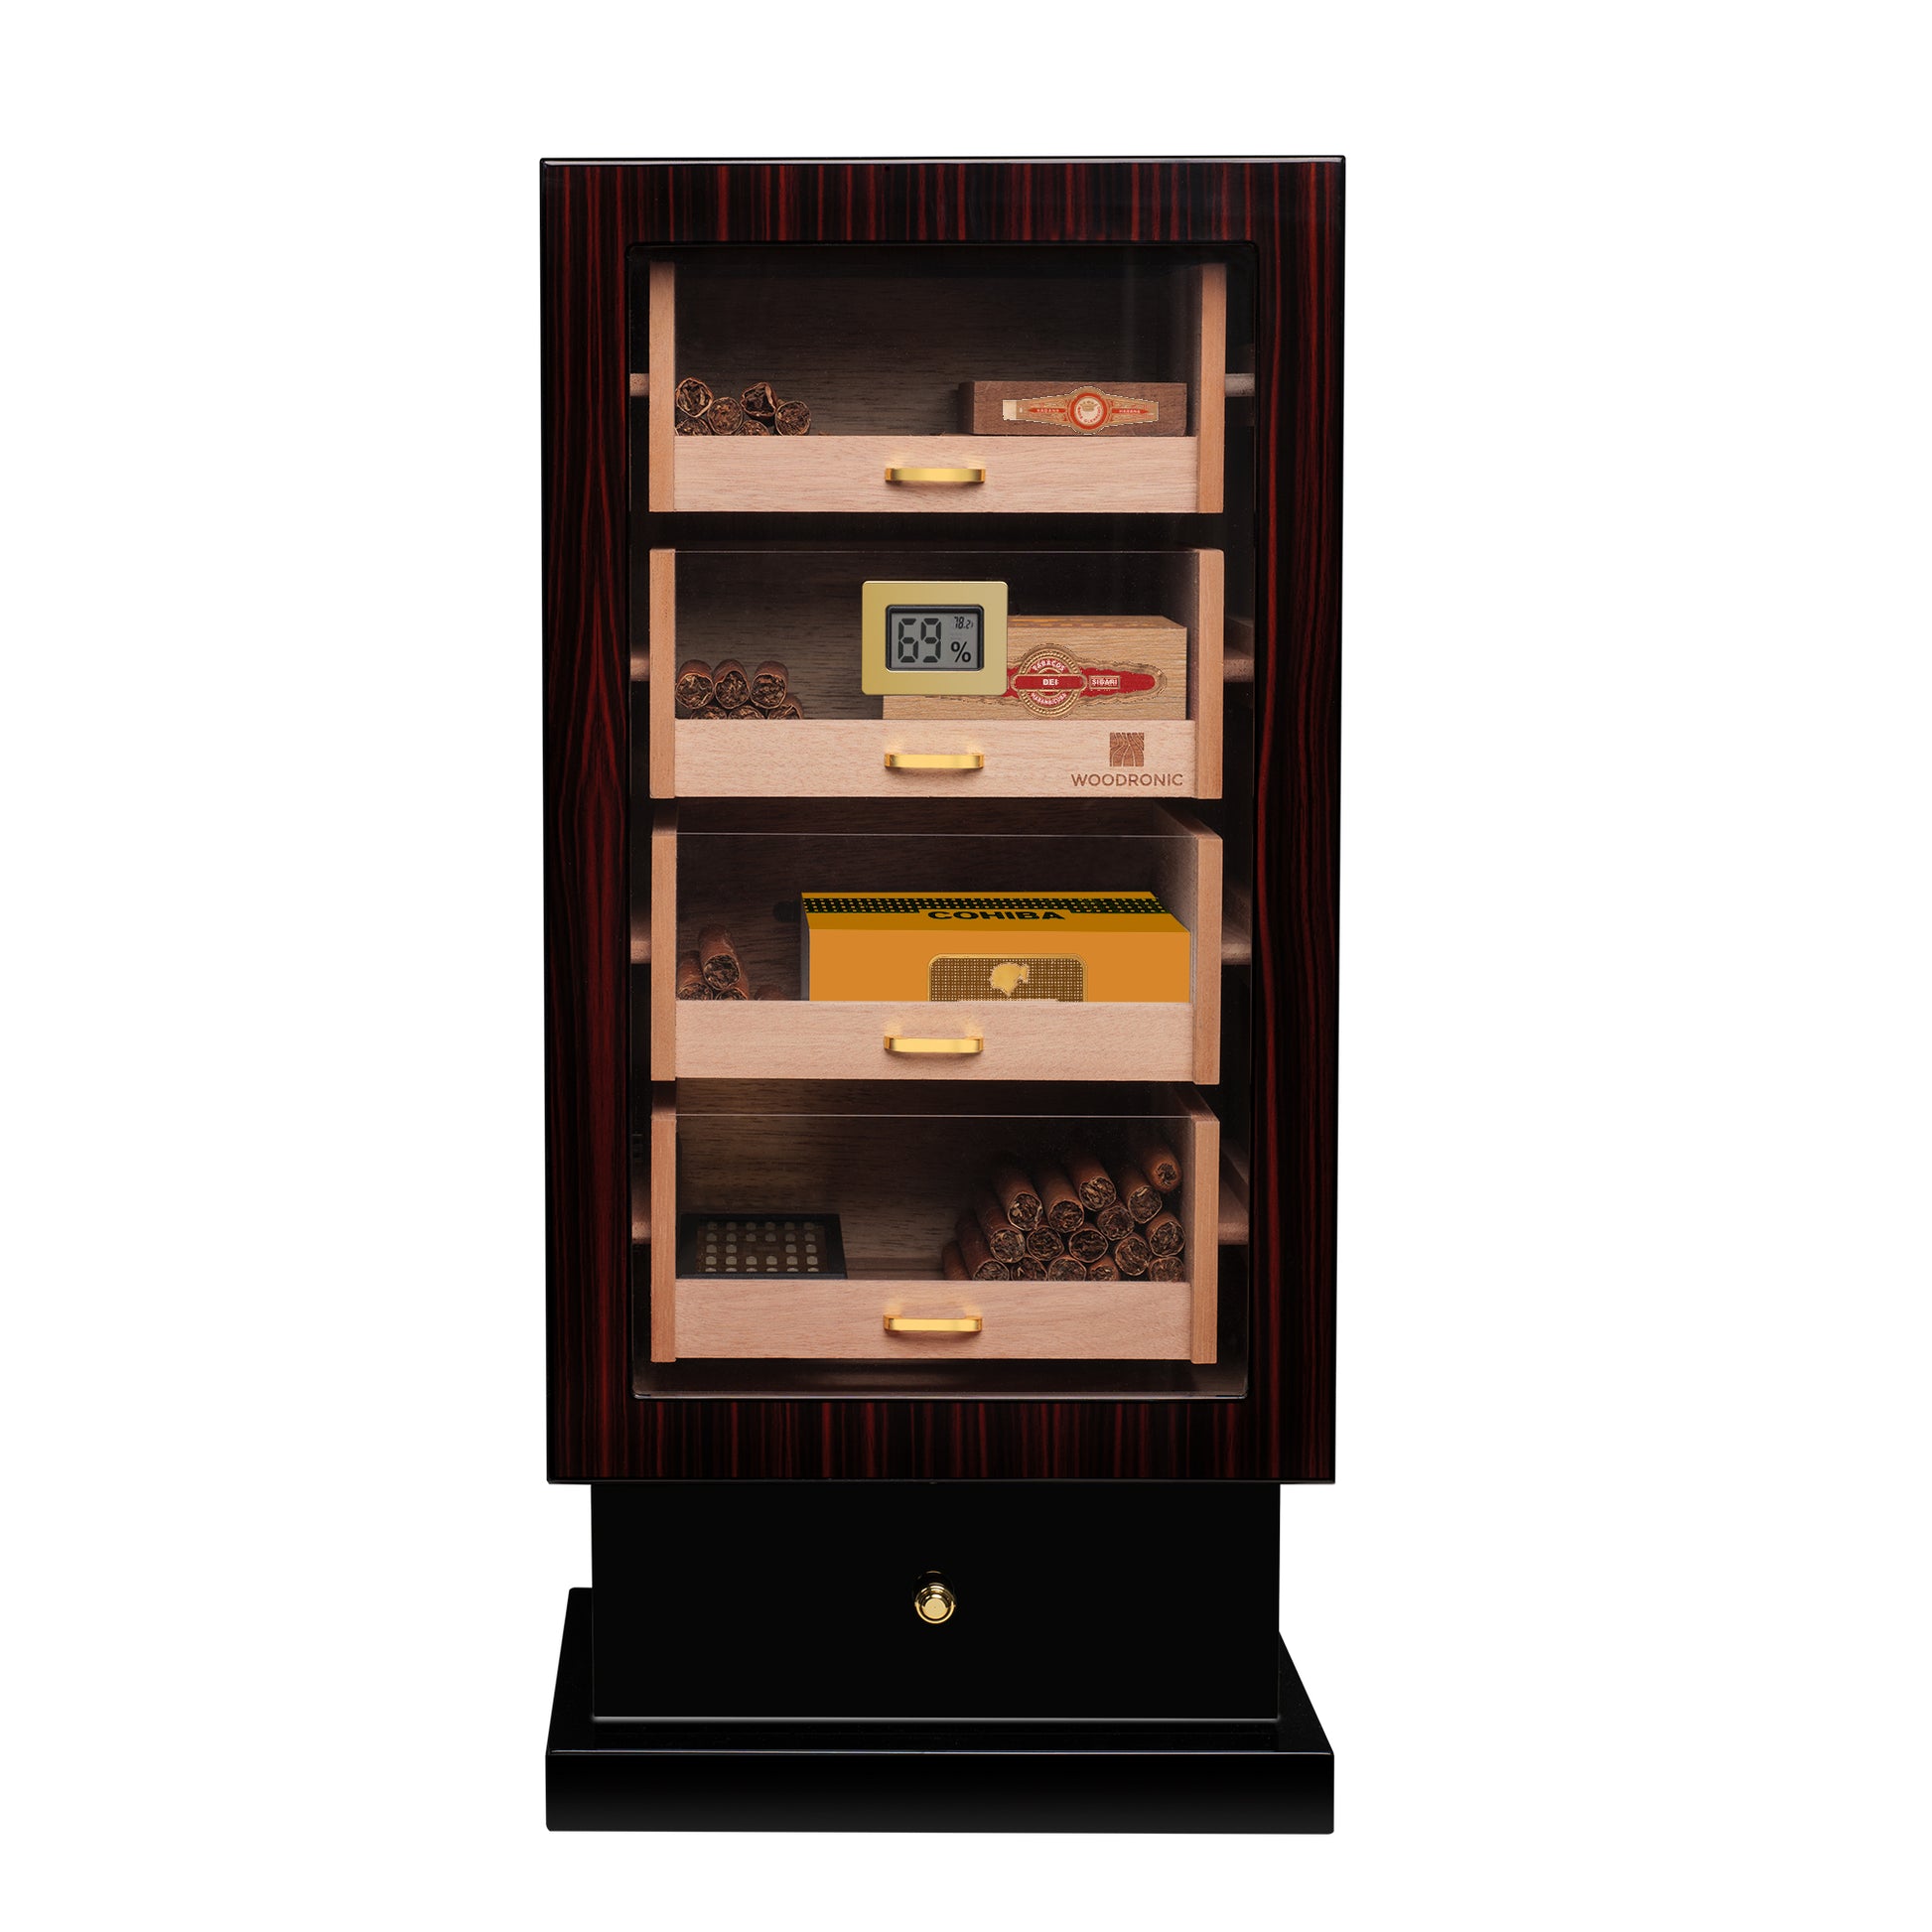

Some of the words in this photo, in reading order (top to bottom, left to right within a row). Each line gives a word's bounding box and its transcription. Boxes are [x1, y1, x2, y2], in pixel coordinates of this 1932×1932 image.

[897, 618, 942, 663] 69
[1070, 773, 1183, 787] WOODRONIC
[927, 910, 1065, 920] COHIBA
